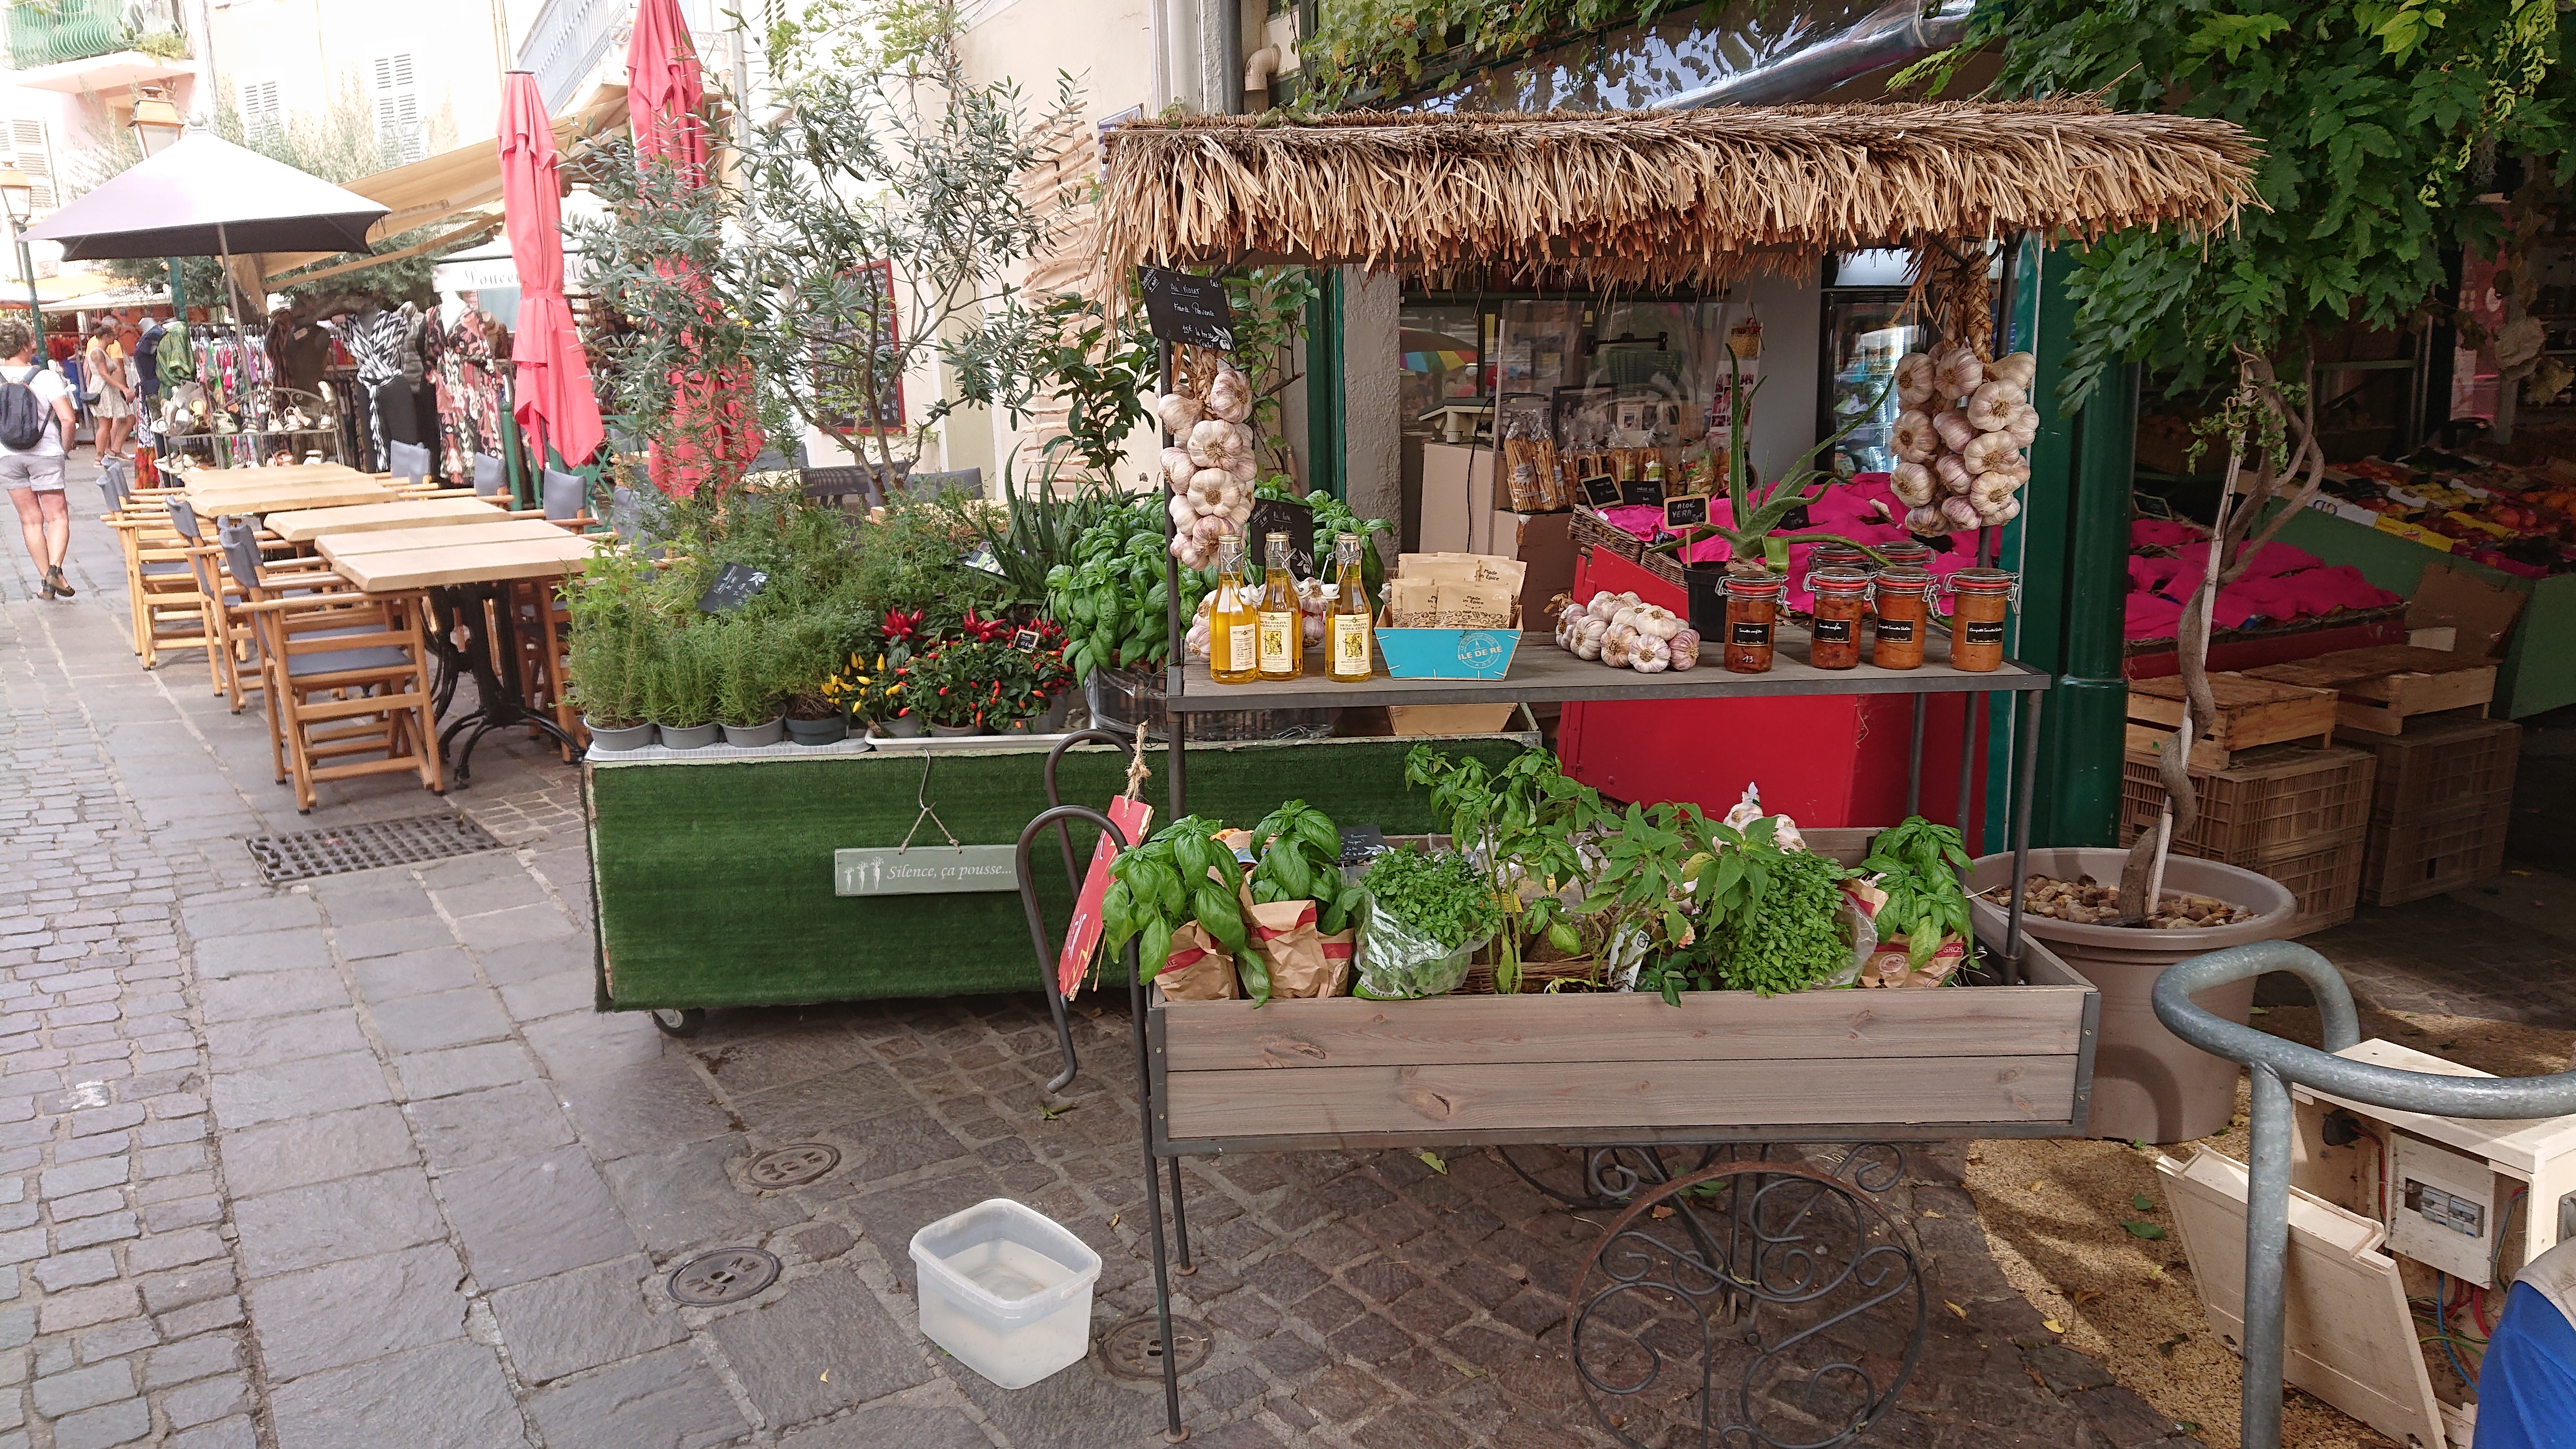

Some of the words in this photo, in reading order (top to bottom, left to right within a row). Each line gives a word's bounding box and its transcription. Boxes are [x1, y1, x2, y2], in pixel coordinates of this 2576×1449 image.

[1183, 286, 1201, 295] VIOLET
[1672, 510, 1692, 519] VERA
[1457, 652, 1473, 660] ILE
[1742, 654, 1754, 663] 13
[886, 864, 937, 880] Silence,
[941, 865, 956, 880] ça
[958, 864, 1012, 880] pousse...
